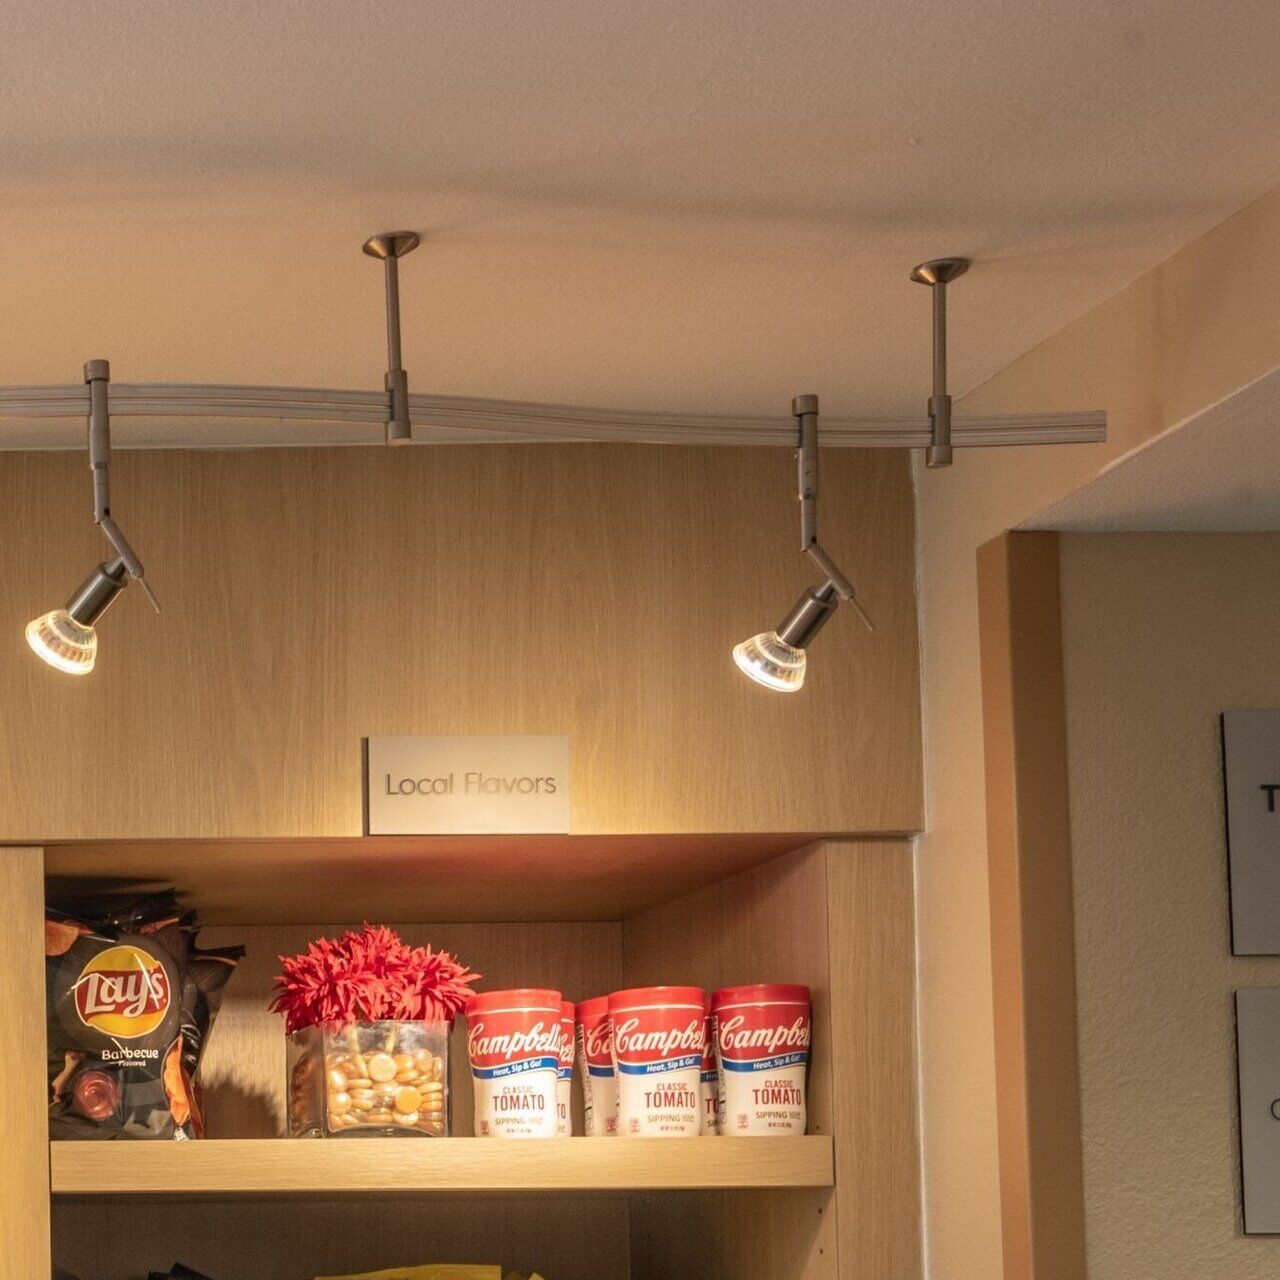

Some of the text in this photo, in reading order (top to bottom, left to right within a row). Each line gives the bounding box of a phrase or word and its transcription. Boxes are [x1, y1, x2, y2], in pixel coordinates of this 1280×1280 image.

[386, 772, 557, 796] Local Flavors
[84, 967, 165, 1018] Lay's
[616, 1018, 705, 1057] Campbel
[101, 1046, 159, 1061] Barbecue
[492, 1094, 545, 1112] TOMATO
[644, 1092, 696, 1109] TOMATO
[752, 1088, 802, 1106] TOMATO
[647, 1114, 681, 1123] SIPPING
